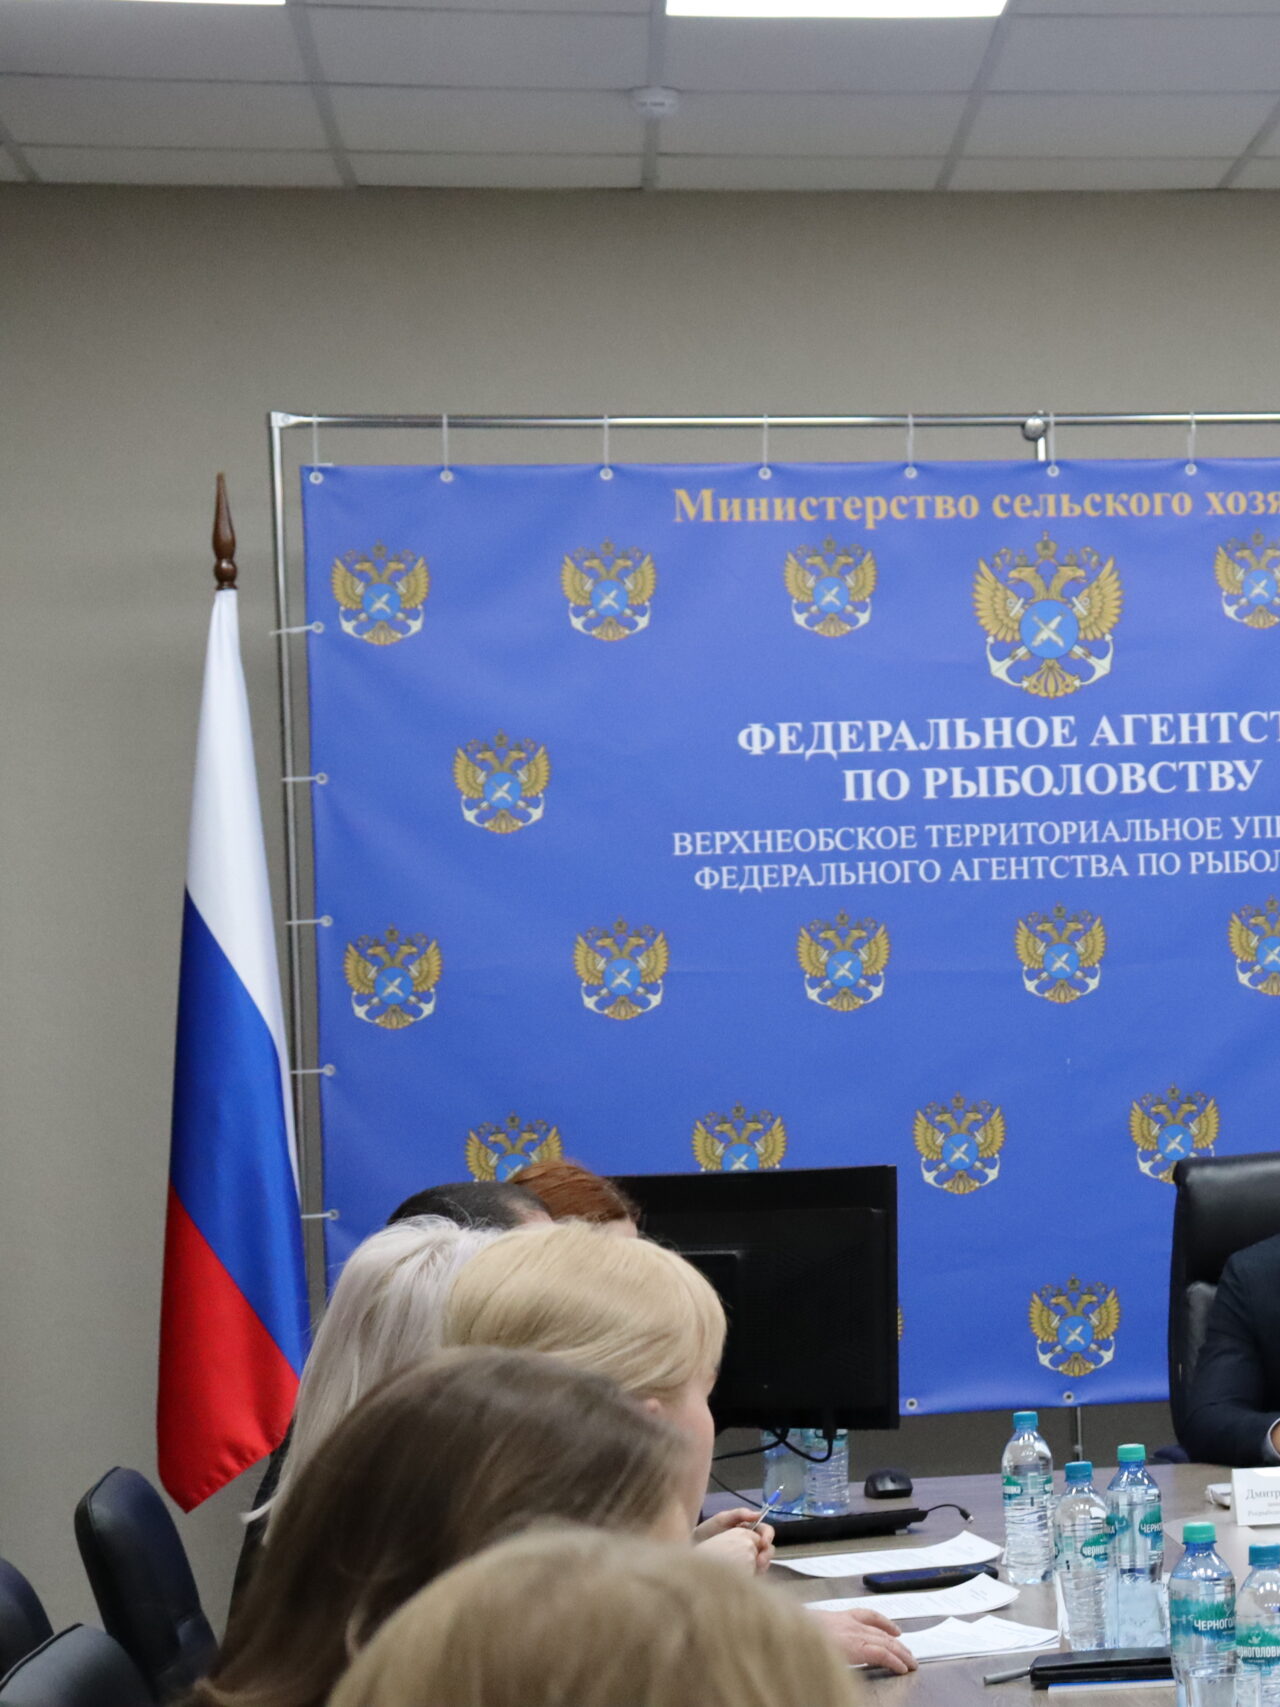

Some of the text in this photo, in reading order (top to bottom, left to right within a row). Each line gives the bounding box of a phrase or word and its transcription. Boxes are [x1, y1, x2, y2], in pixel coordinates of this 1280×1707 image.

[672, 488, 981, 530] Министерство
[991, 492, 1193, 519] сельского
[737, 714, 1078, 761] ФЕДЕРАЛЬНОЕ
[842, 759, 1264, 802] ПО РЫБОЛОВСТВУ
[672, 825, 918, 856] ВЕРХНЕОБСКОЕ
[925, 816, 1223, 849] ТЕРРИТОРИАЛЬНОЕ
[694, 858, 942, 893] ФЕДЕРАЛЬНОГО
[949, 851, 1130, 883] АГЕНТСТВА
[1137, 852, 1181, 877] ПО
